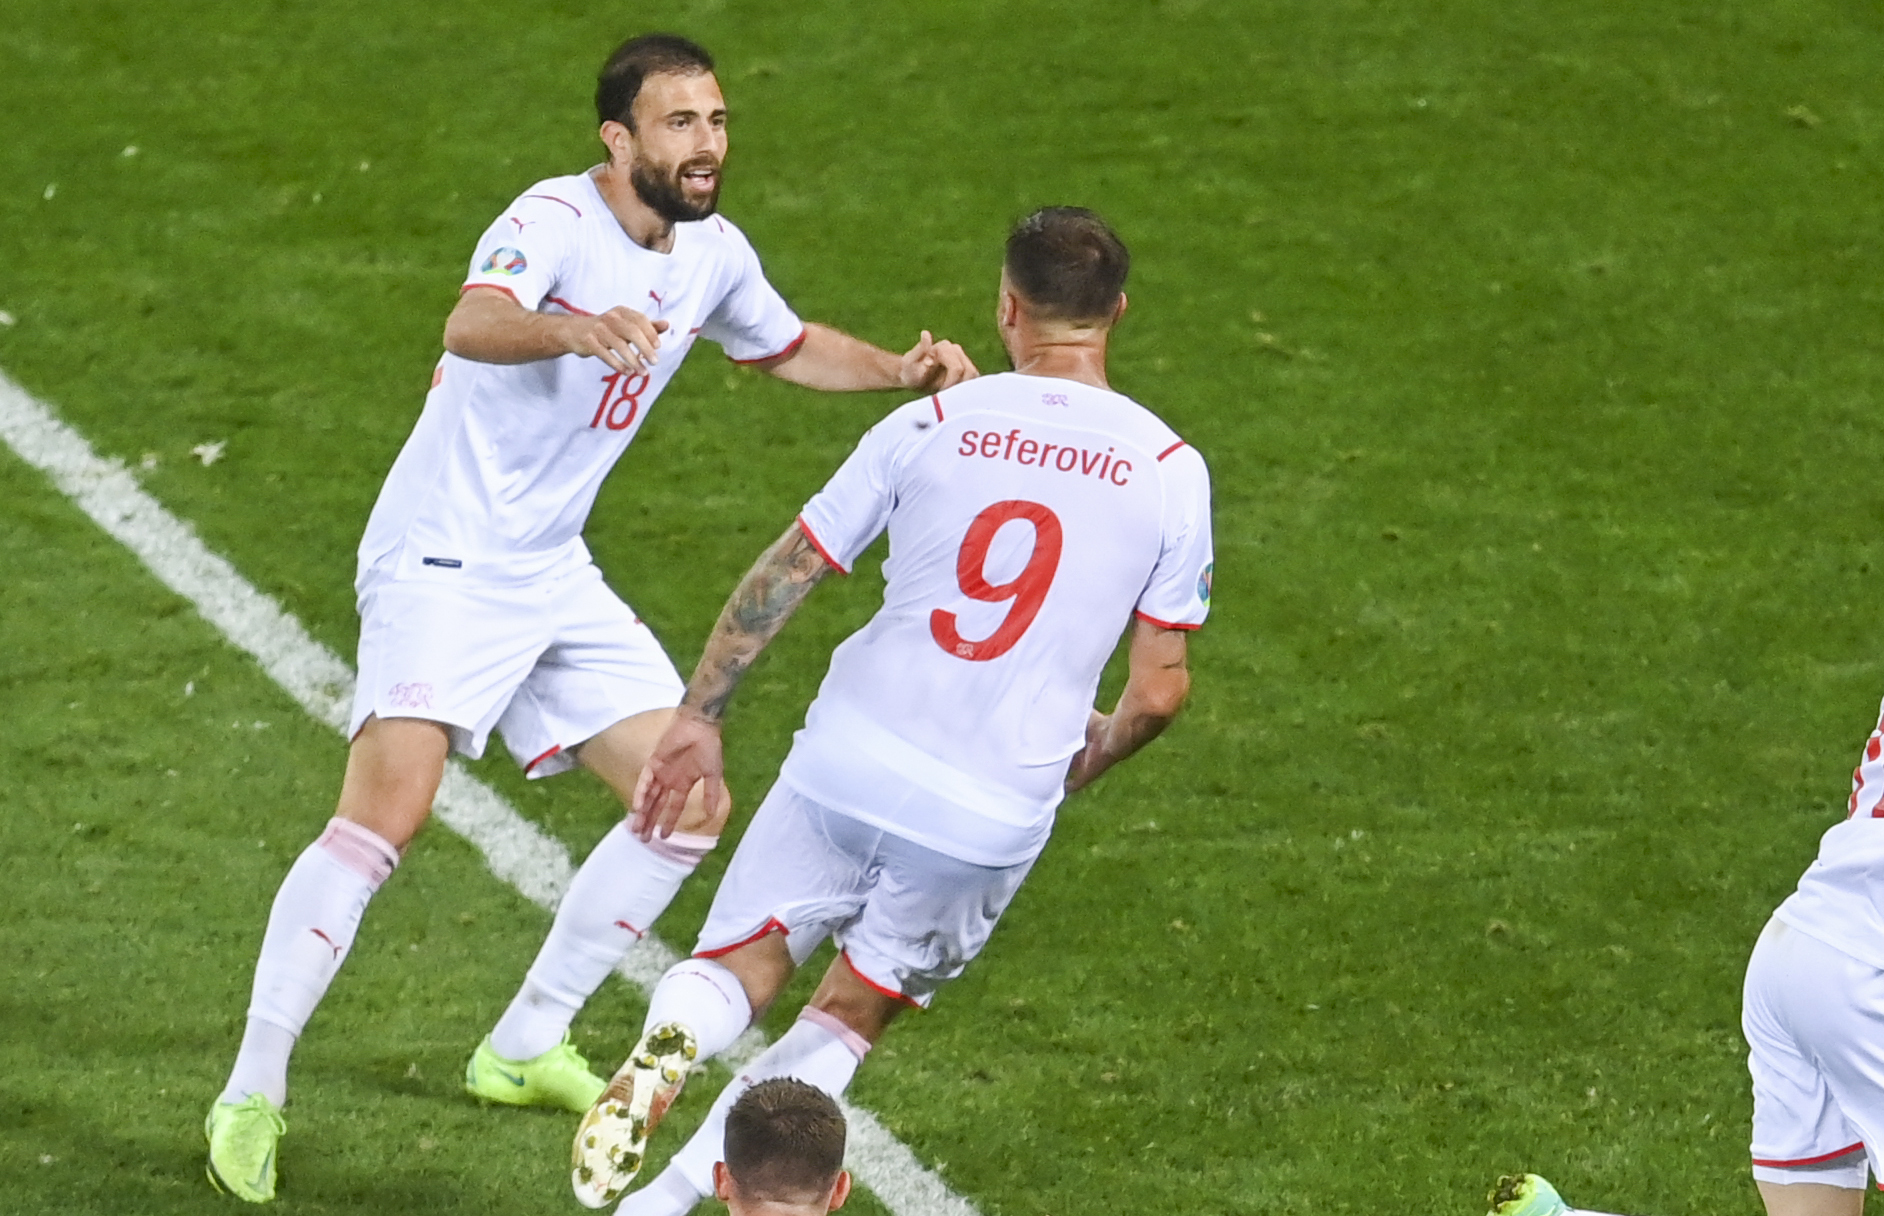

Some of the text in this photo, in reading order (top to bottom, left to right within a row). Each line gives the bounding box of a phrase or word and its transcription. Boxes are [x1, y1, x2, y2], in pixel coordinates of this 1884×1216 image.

[591, 371, 650, 430] 18
[959, 429, 1133, 486] seferovic
[930, 500, 1063, 662] 9
